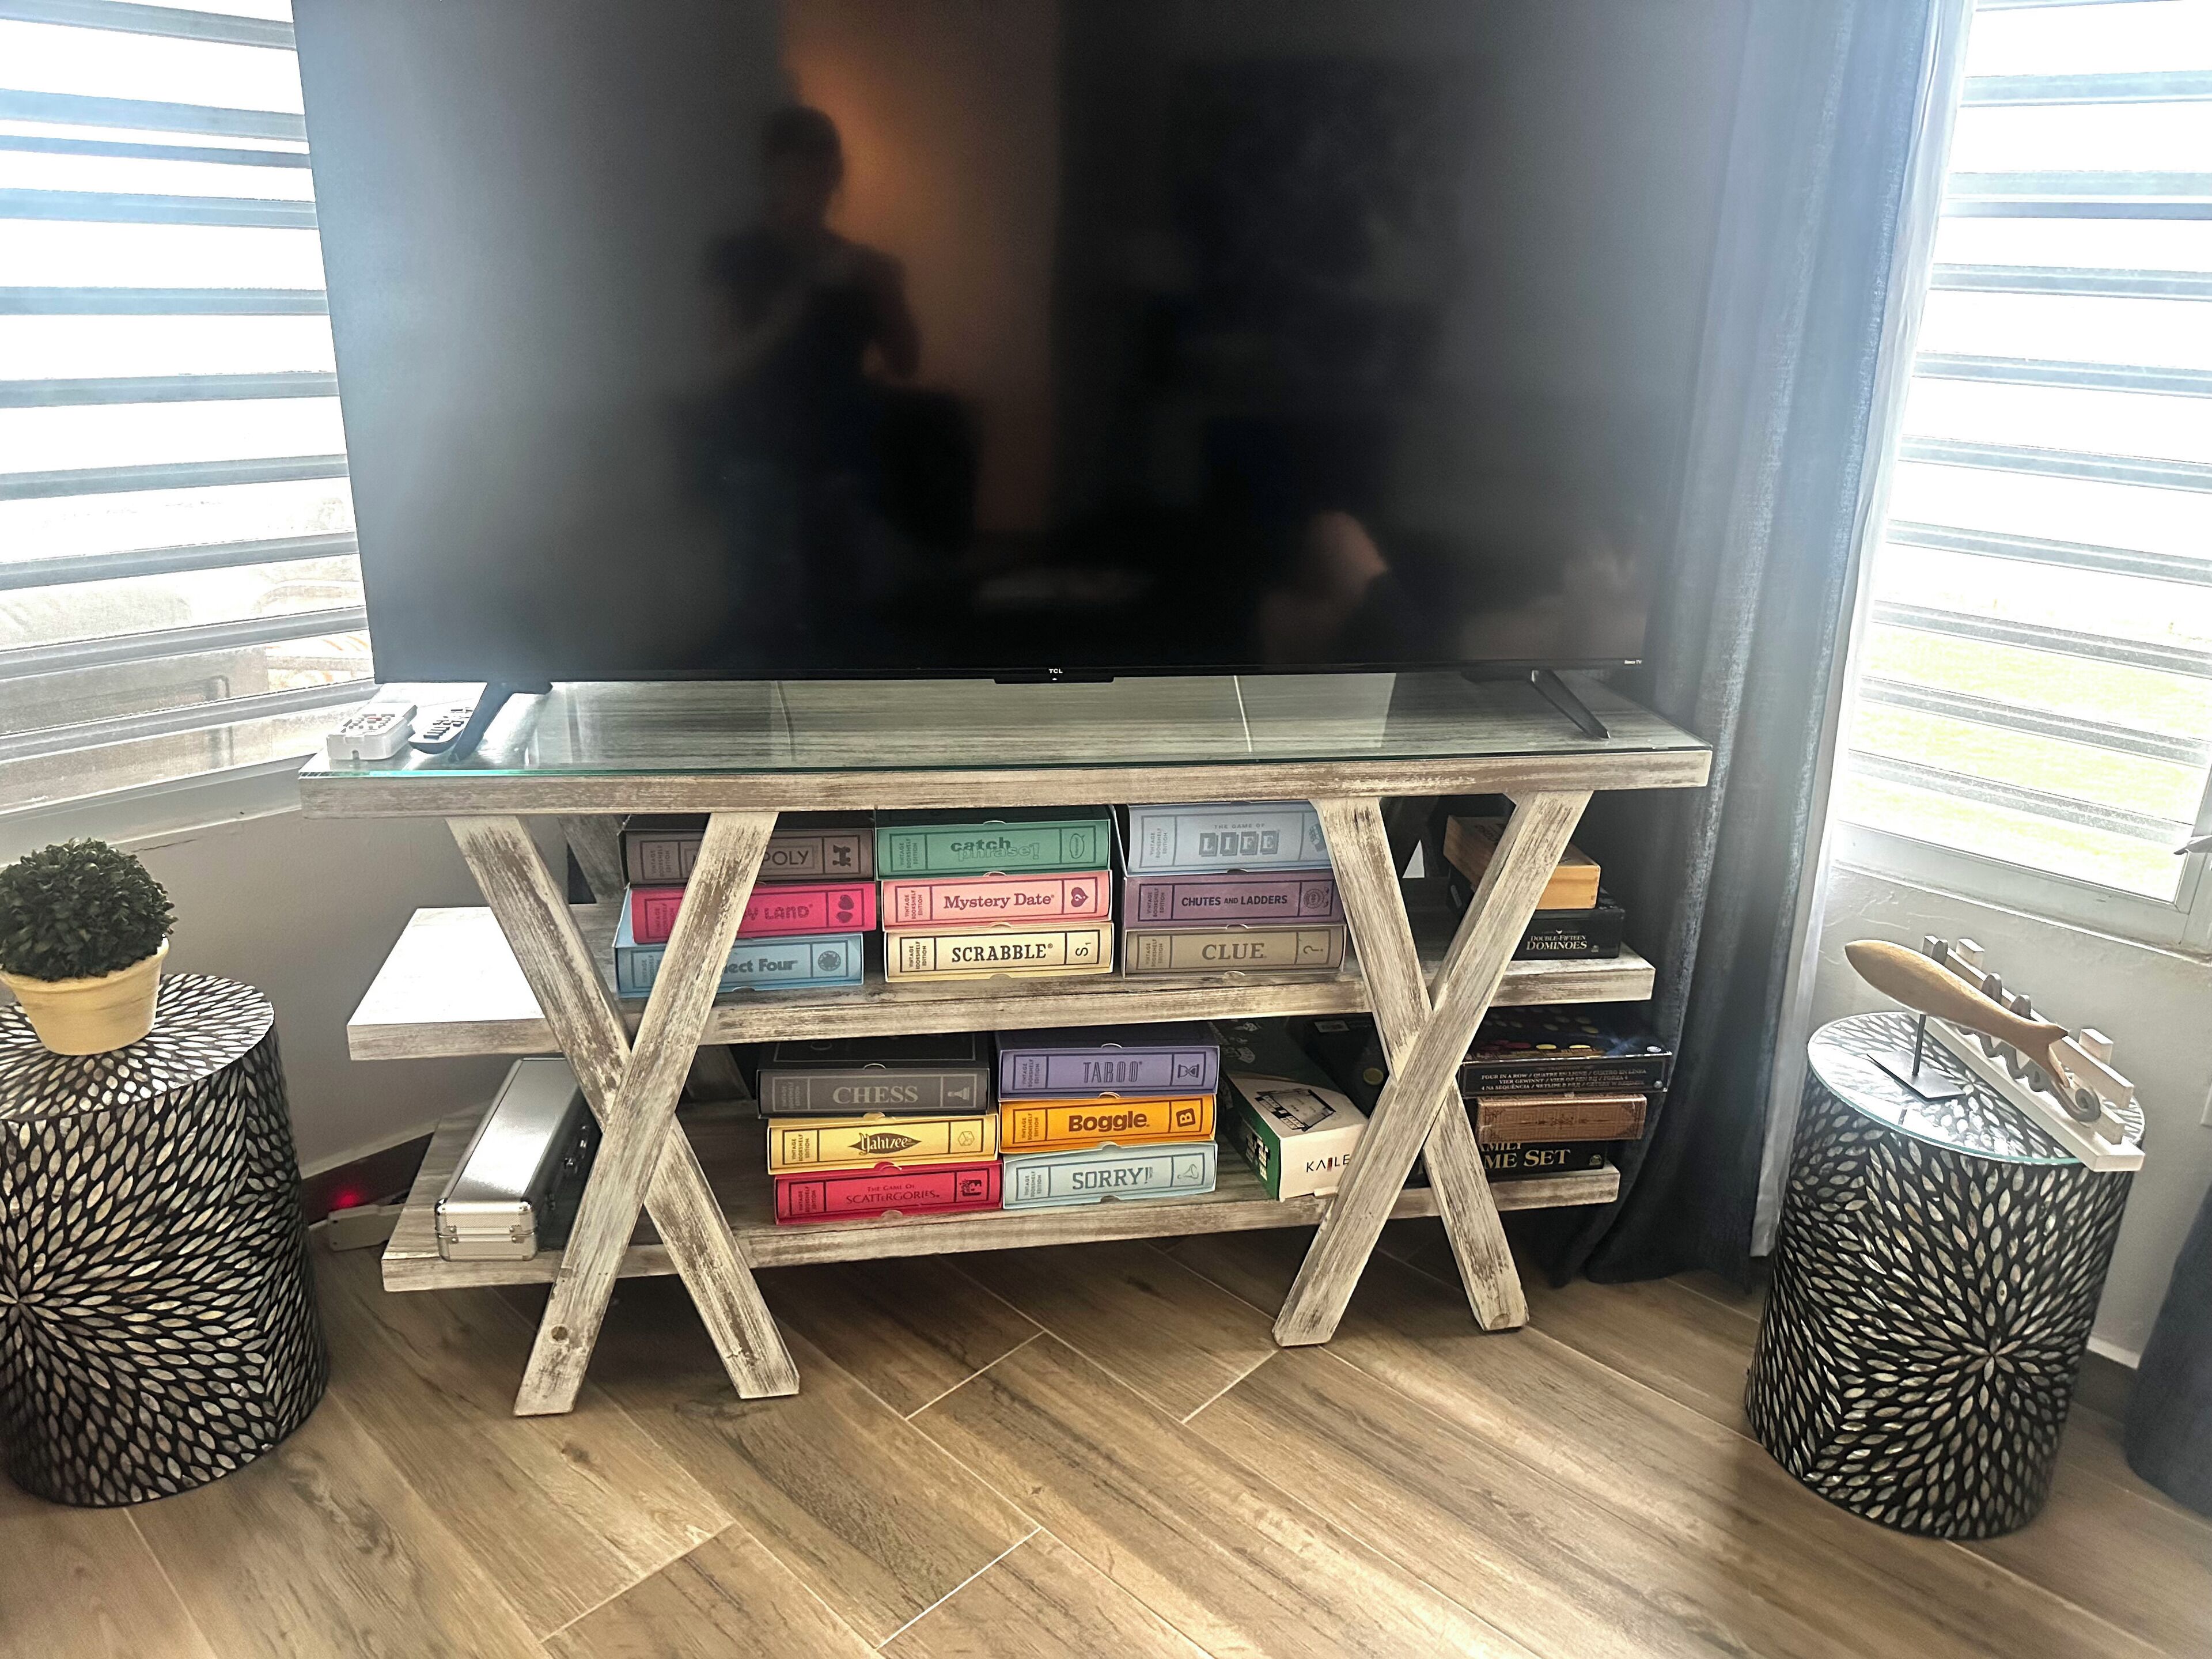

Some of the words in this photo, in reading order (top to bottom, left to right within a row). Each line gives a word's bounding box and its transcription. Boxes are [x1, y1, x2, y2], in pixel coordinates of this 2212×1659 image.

[950, 837, 1011, 852] catch
[1200, 832, 1278, 855] LIFE
[944, 895, 1011, 910] Mystery
[1014, 893, 1052, 906] Date
[1181, 896, 1221, 906] CHUTES
[1240, 895, 1288, 906] LADDERS
[764, 906, 809, 920] LAND
[952, 944, 1046, 963] SCRABBLE
[1202, 943, 1265, 960] CLUE
[1527, 941, 1588, 950] DOMINOES
[759, 959, 798, 972] Four
[1084, 1061, 1139, 1083] TABOO
[833, 1085, 919, 1104] CHESS
[1069, 1111, 1147, 1132] Boggle
[859, 1132, 908, 1156] Yahtzee
[1524, 1149, 1571, 1166] SET
[1073, 1167, 1150, 1190] SORRY!
[846, 1190, 935, 1203] SCATTERGORIES
